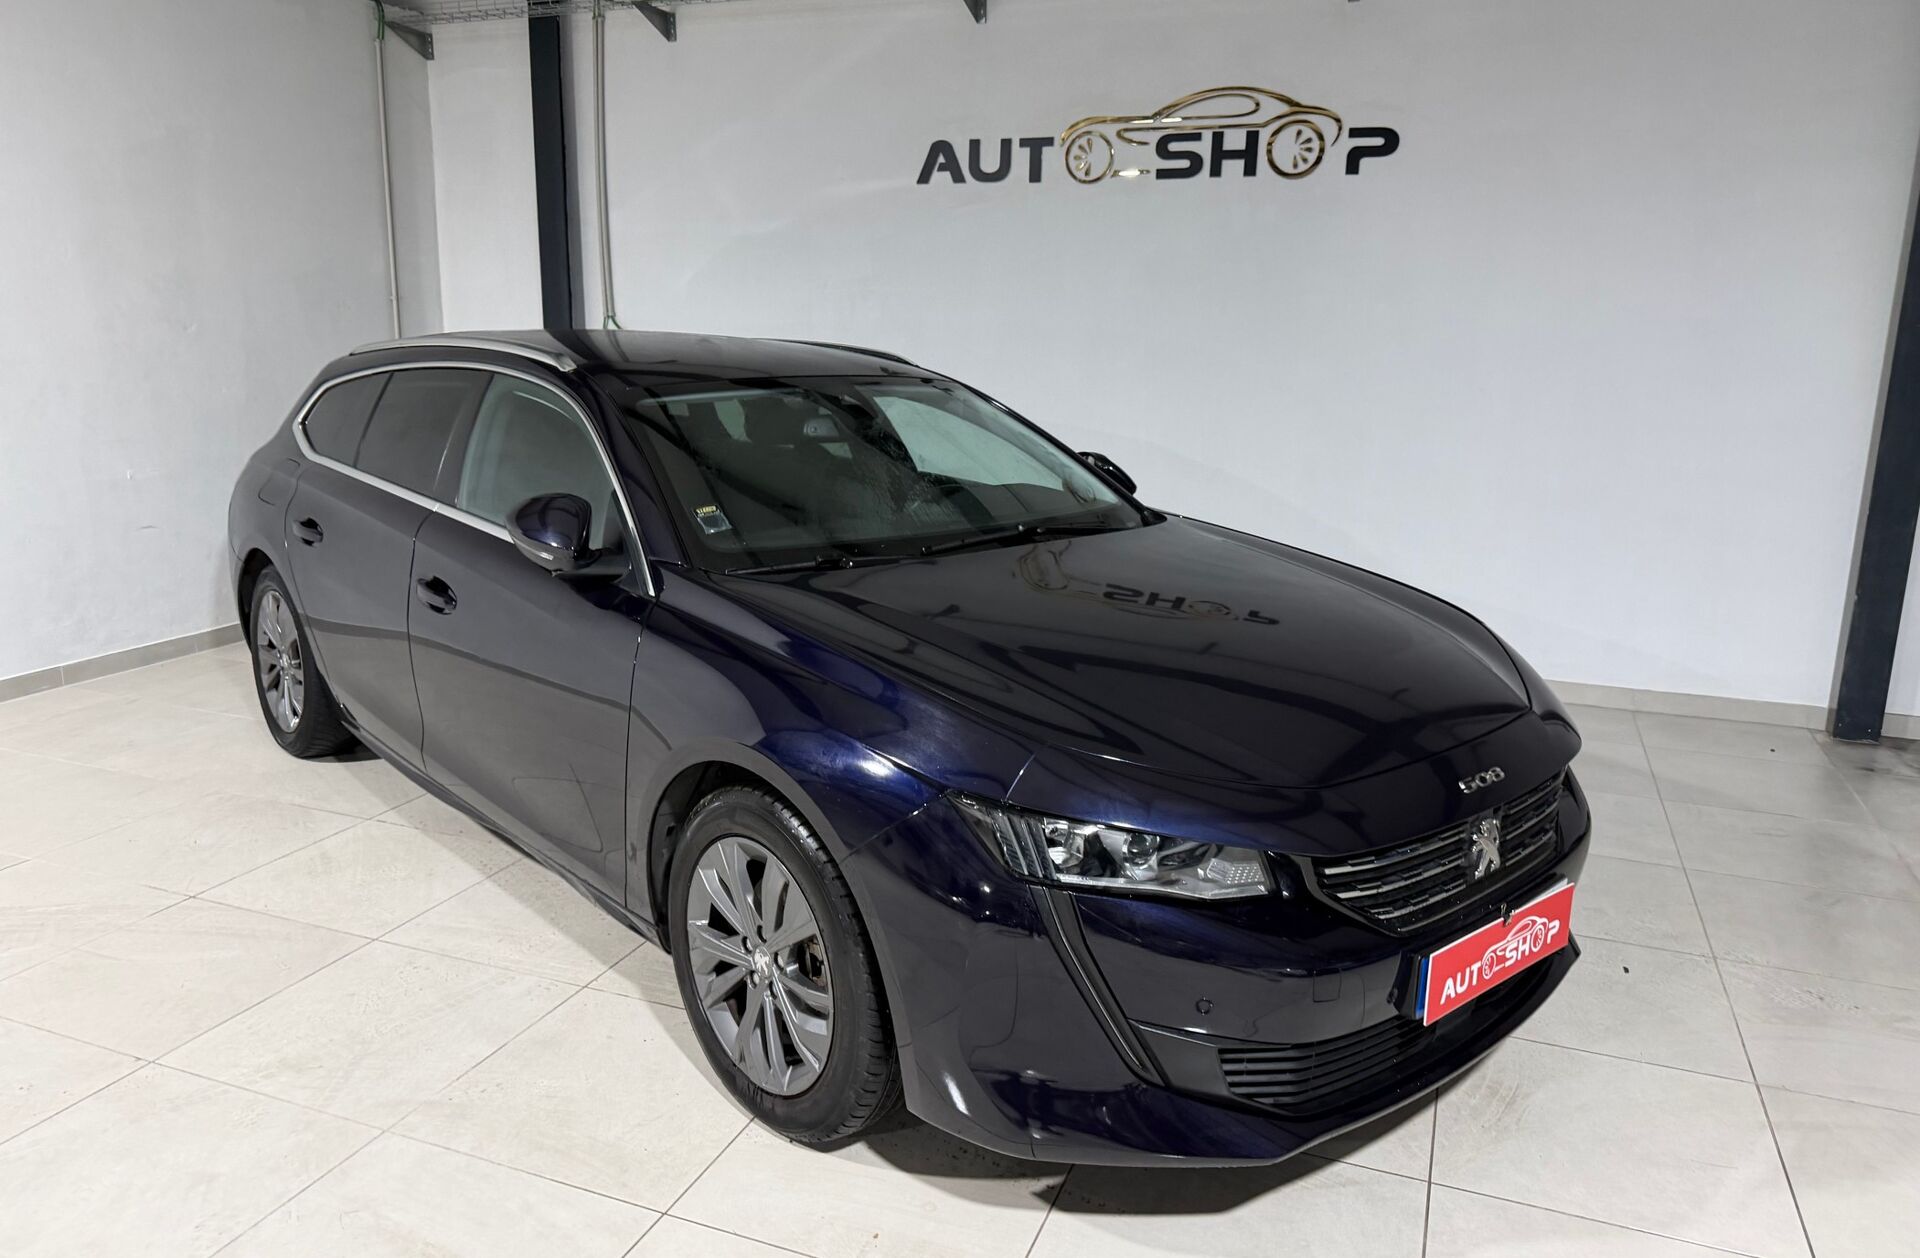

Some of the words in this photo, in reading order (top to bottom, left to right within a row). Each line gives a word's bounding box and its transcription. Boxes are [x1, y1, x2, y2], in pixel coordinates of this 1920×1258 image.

[917, 131, 1114, 184] AUTO
[1156, 127, 1400, 180] SHOP
[1458, 766, 1505, 793] 508
[1440, 952, 1498, 1004] AUTO
[1504, 919, 1560, 967] SHOP
